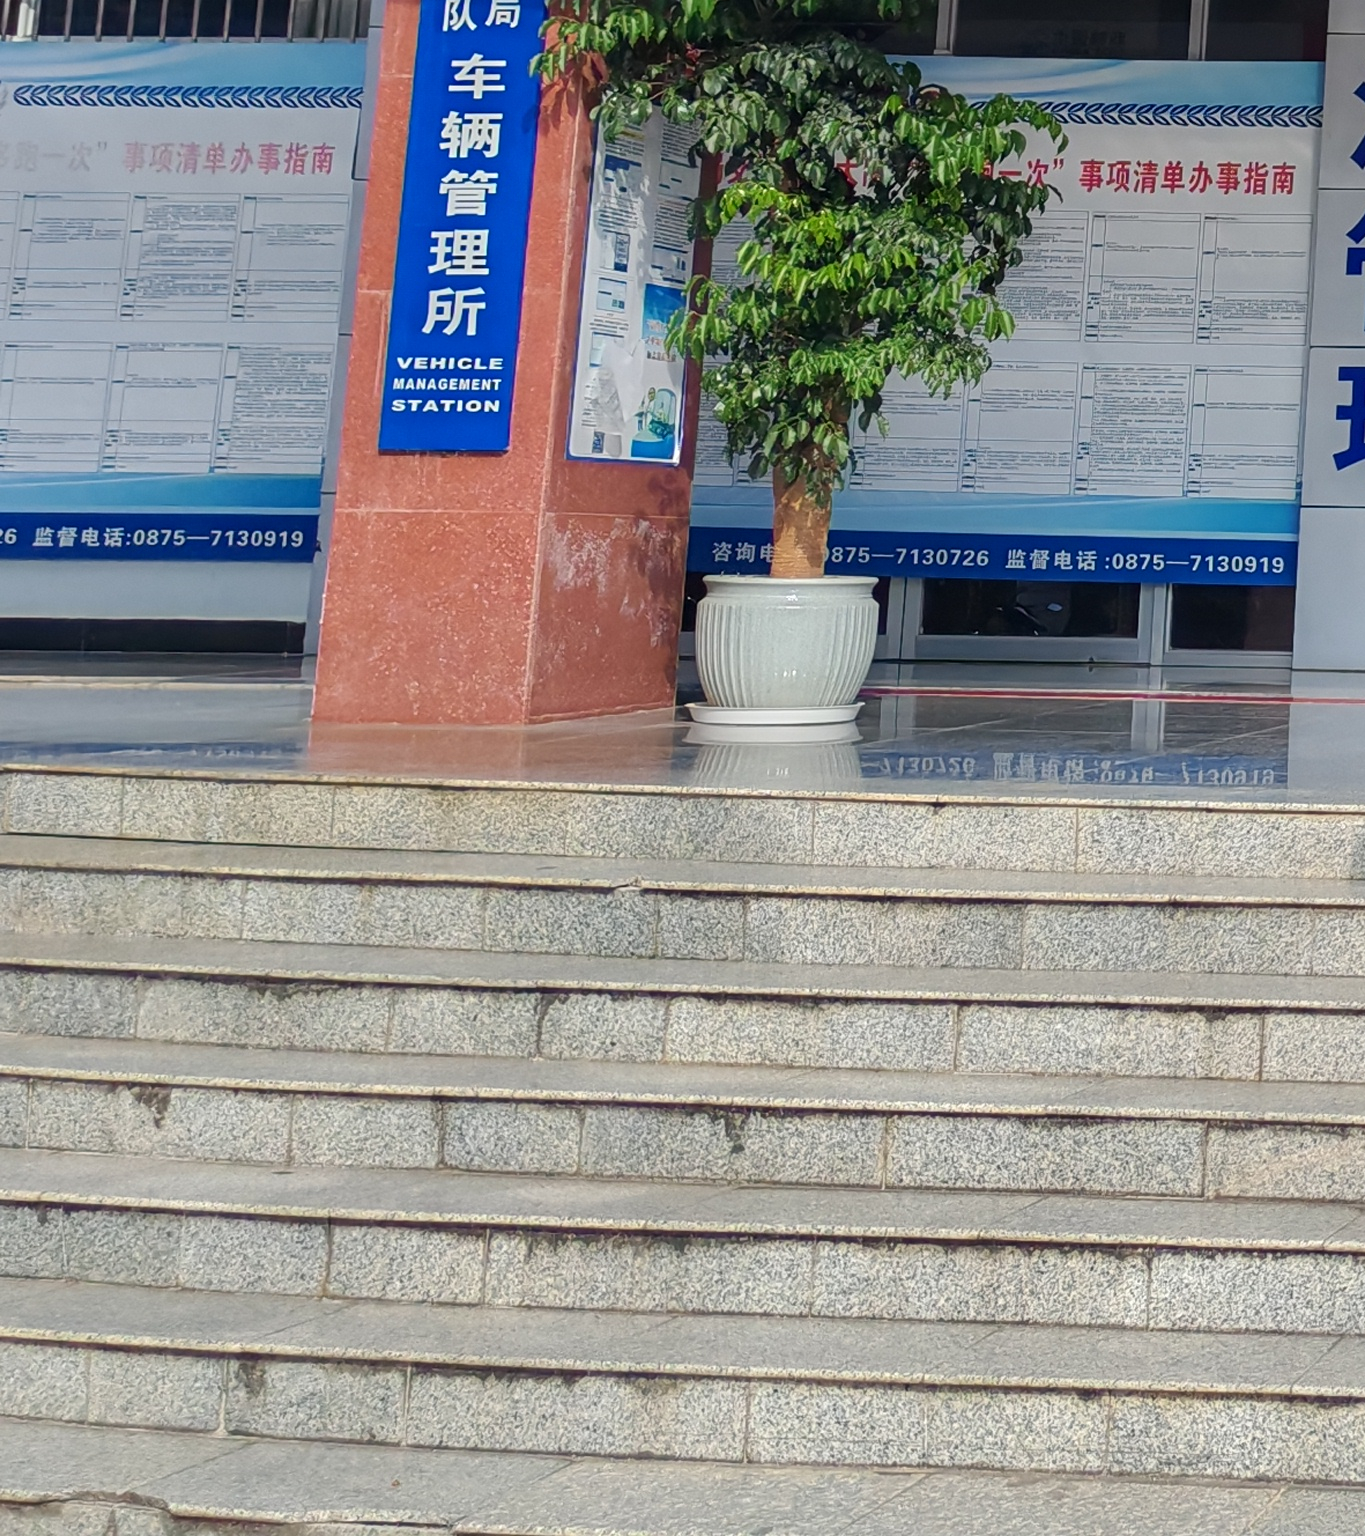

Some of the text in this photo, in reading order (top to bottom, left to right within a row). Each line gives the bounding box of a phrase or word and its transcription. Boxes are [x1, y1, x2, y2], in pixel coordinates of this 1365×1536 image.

[421, 53, 507, 337] 车辆管理所
[396, 357, 504, 371] VEHICLE
[393, 377, 502, 392] MANAGEMENT
[391, 399, 501, 413] STATION
